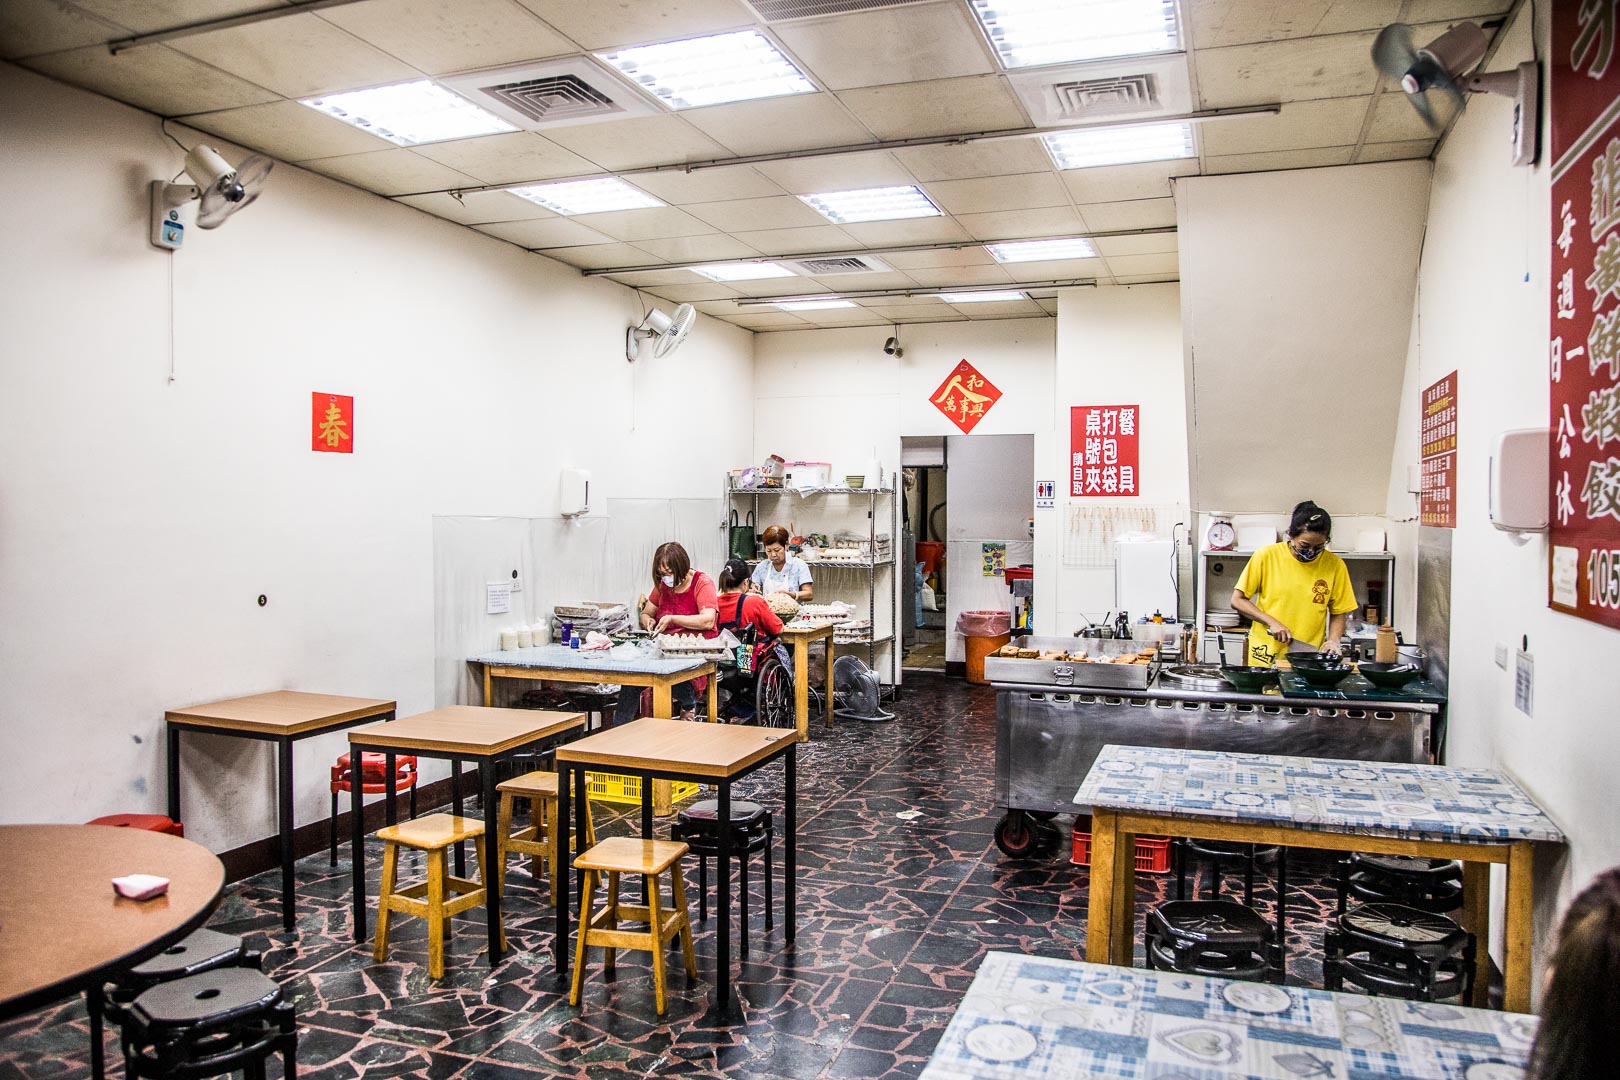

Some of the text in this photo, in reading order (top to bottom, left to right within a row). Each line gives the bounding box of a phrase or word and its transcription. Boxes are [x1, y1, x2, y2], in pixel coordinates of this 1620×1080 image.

[317, 402, 349, 447] 春
[1085, 408, 1101, 494] 桌號夾
[1102, 408, 1118, 493] 打包袋
[1118, 407, 1135, 493] 餐具
[1072, 451, 1083, 495] 請自取
